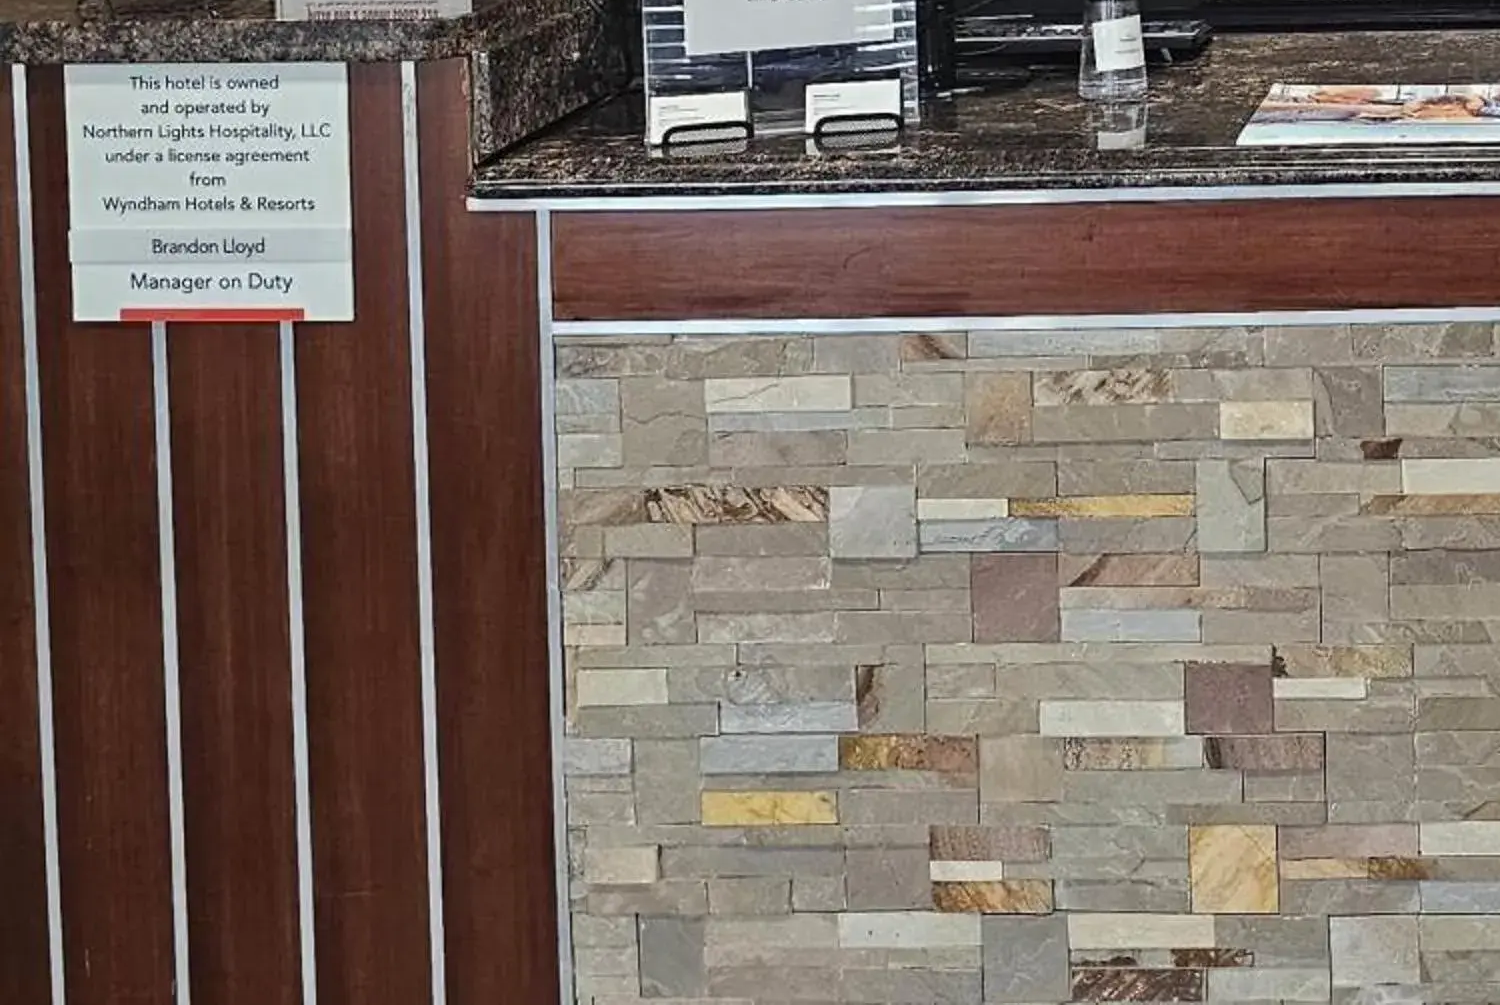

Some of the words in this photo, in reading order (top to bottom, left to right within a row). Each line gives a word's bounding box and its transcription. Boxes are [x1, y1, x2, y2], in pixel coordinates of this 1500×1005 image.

[129, 76, 161, 91] This
[165, 75, 204, 90] hotel
[210, 75, 221, 90] is
[226, 75, 279, 90] owned
[140, 99, 169, 114] and
[175, 99, 246, 119] operated
[251, 99, 270, 118] by
[83, 124, 153, 139] Northern
[158, 123, 204, 142] Lights
[210, 123, 297, 143] Hospitality,
[300, 123, 332, 138] LLC
[105, 148, 150, 163] under
[154, 152, 163, 163] a
[168, 147, 220, 162] license
[225, 149, 310, 166] agreement
[189, 171, 226, 186] from
[103, 196, 180, 216] Wyndham
[185, 196, 235, 211] Hotels
[240, 197, 252, 210] &
[257, 196, 315, 211] Resorts
[152, 239, 218, 254] Brandon
[223, 239, 266, 258] Lloyd
[130, 273, 211, 293] Manager
[219, 277, 242, 290] on
[248, 273, 293, 293] Duty
